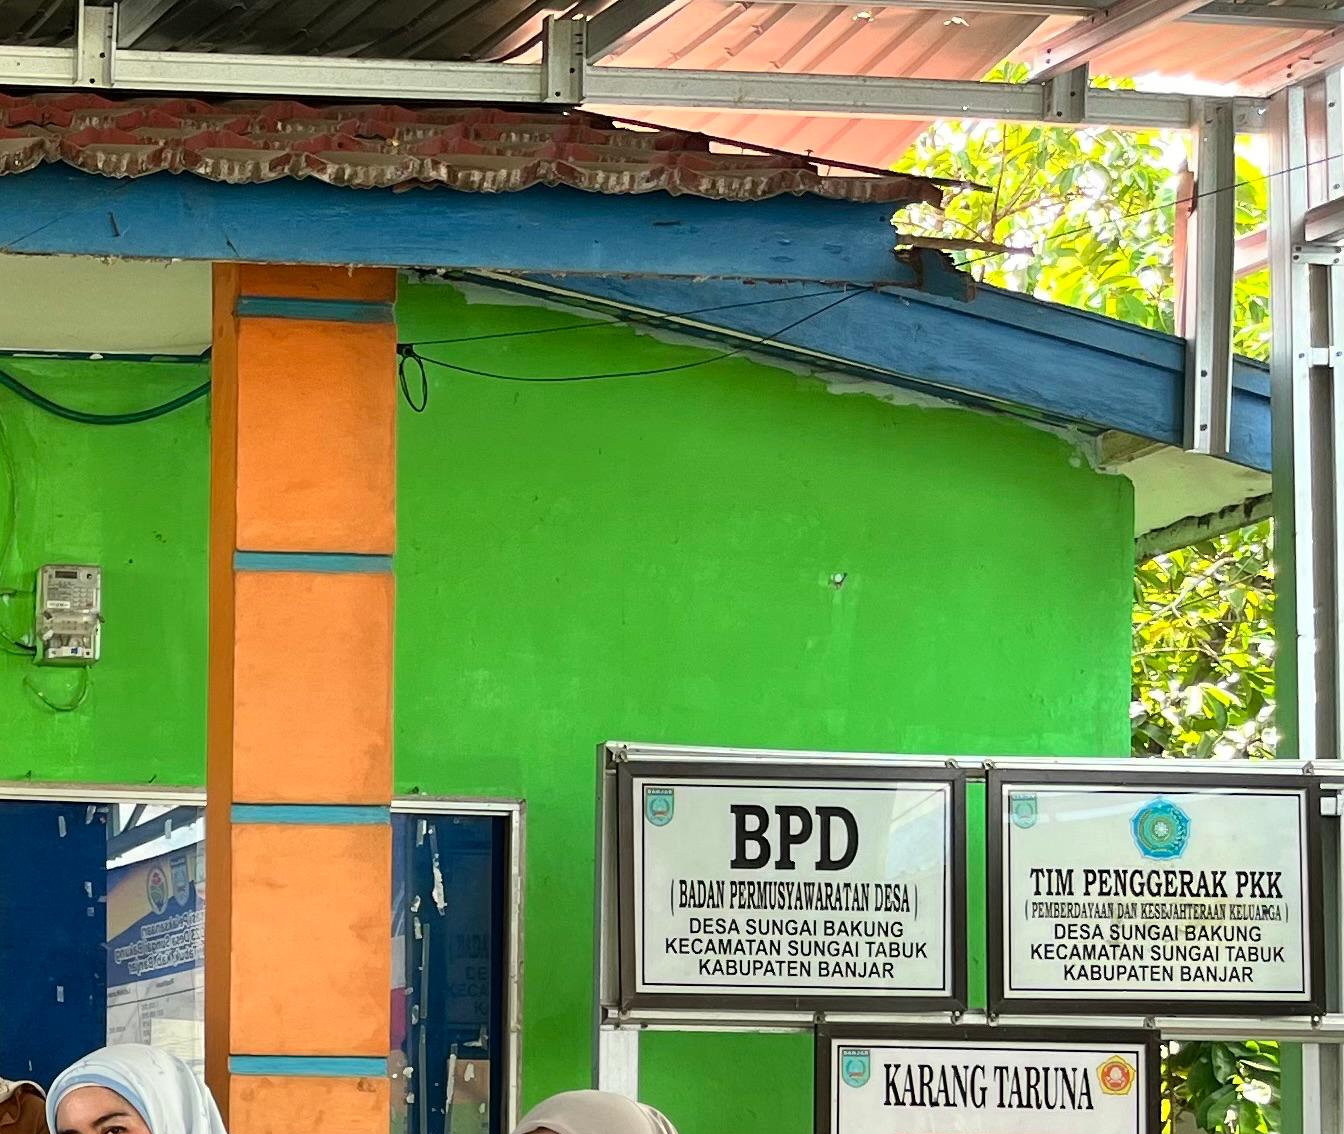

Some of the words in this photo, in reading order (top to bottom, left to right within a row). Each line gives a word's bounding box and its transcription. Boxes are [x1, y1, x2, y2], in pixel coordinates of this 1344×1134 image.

[730, 804, 859, 871] BPD
[1030, 868, 1074, 897] TIM
[1083, 869, 1227, 898] PENGGERAK
[1236, 870, 1283, 899] PKK
[679, 880, 724, 909] BADAN
[730, 880, 869, 912] PERMUSYAWARATAN
[874, 883, 910, 912] DESA
[1032, 901, 1112, 919] PEMBERDAYAAN
[1117, 902, 1137, 920] DAN
[1141, 902, 1225, 921] KESEJAHTERAAN
[1229, 904, 1281, 921] KELUARGA
[689, 918, 740, 934] DESA
[746, 919, 816, 936] SUNGAI
[824, 920, 904, 937] BAKUNG
[1054, 923, 1104, 940] DESA
[1109, 924, 1178, 941] SUNGAI
[1185, 925, 1261, 942] BAKUNG
[666, 937, 781, 956] KECAMATAN
[788, 940, 858, 957] SUNGAI
[865, 942, 928, 959] TABUK
[1031, 943, 1144, 961] KECAMATAN
[1150, 945, 1219, 962] SUNGAI
[1225, 946, 1285, 963] TABUK
[699, 959, 811, 977] KABUPATEN
[818, 961, 894, 979] BANJAR
[1064, 964, 1173, 982] KABUPATEN
[1181, 966, 1253, 982] BANJAR
[883, 1063, 988, 1108] KARANG
[993, 1065, 1094, 1110] TARUNA
